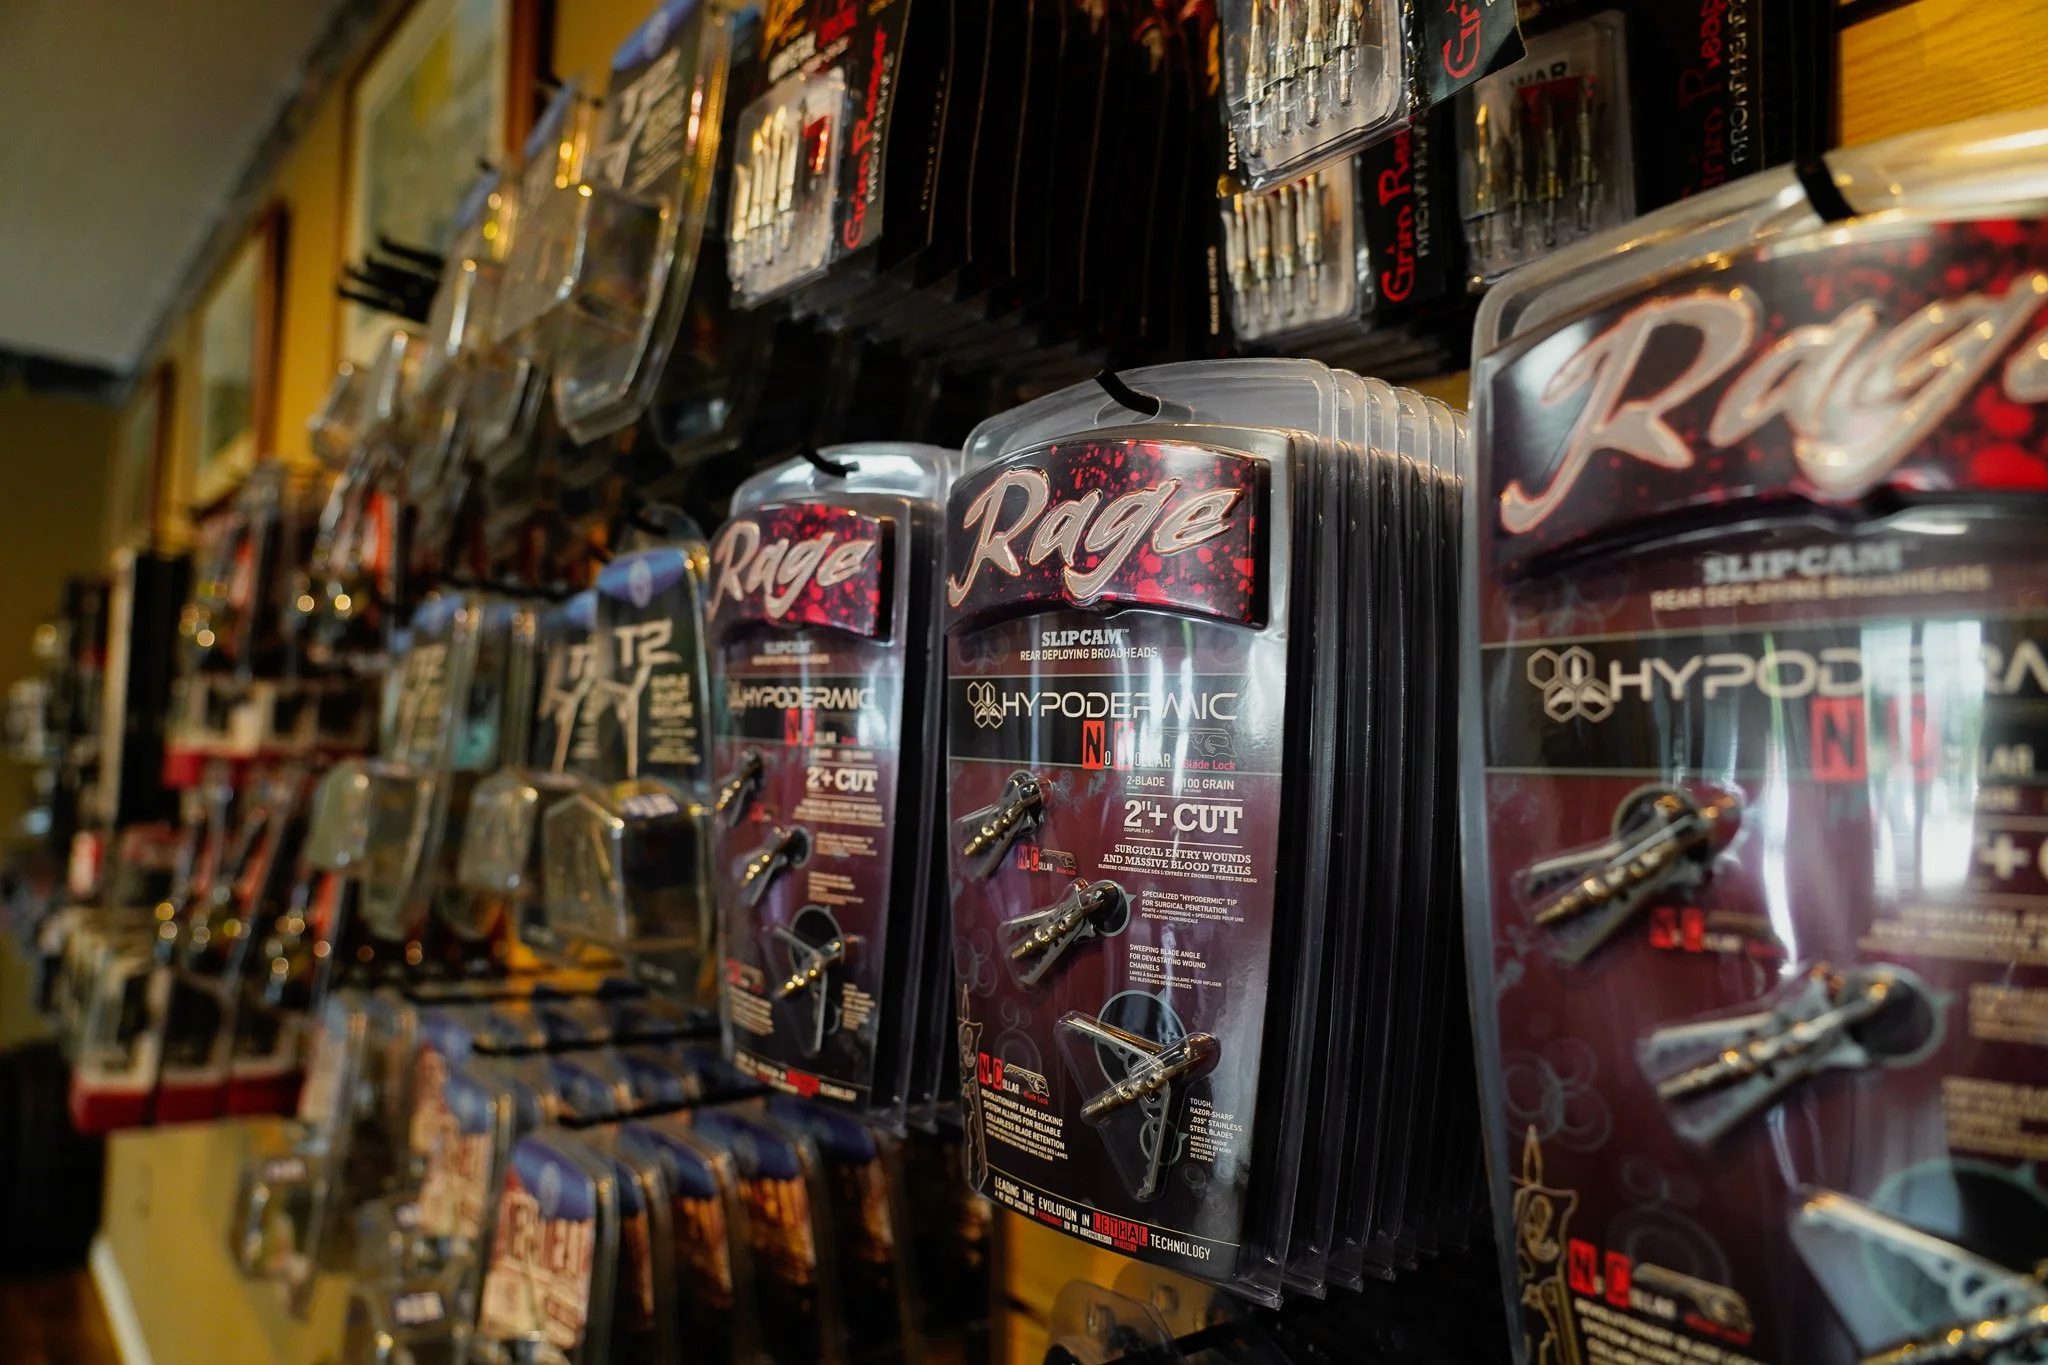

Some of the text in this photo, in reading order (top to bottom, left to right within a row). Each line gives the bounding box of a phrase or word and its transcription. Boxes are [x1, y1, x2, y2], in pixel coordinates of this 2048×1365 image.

[1442, 0, 1481, 78] Gr
[1382, 204, 1414, 302] Grim
[948, 466, 1242, 607] Rage
[708, 519, 876, 622] Rage
[1020, 647, 1158, 662] REAR DEPLOYING BROADHEADS
[1183, 759, 1236, 771] Blade Lock
[834, 768, 878, 792] CUT
[1126, 775, 1235, 791] 2-BLADE 100 GRAIN
[1173, 803, 1243, 834] CUT
[1115, 844, 1251, 864] SURGICAL ENTRY WOUNDS
[1103, 854, 1251, 876] AND MASSIVE BLOOD TRAILS
[1142, 890, 1179, 900] SPECIALIZED
[1227, 898, 1238, 906] TIP
[1142, 899, 1228, 914] FOR SURGICAL PENETRATION
[1129, 944, 1201, 959] SWEEPING BLADE ANGLE
[1129, 962, 1160, 971] CHANNELS
[1142, 954, 1181, 966] DEVASTATING
[1182, 960, 1206, 969] WOUND
[981, 1088, 1063, 1127] REVOLUTIONARY BLADE LOCKING
[1189, 1097, 1213, 1108] TOUGH,
[983, 1099, 1001, 1114] SYSTEM
[1001, 1107, 1022, 1122] ALLOWS
[1022, 1116, 1033, 1127] FOR
[1034, 1121, 1061, 1138] RELIABLE
[1189, 1106, 1234, 1120] RAZOR-SHARP
[985, 1111, 1014, 1131] COLLARLESS
[1014, 1124, 1032, 1138] BLADE
[1032, 1131, 1065, 1150] RETENTION
[1189, 1124, 1234, 1140] STEEL BLADES
[1208, 1120, 1243, 1132] STAINLESS
[995, 1175, 1019, 1199] LEADING
[1022, 1189, 1035, 1206] THE
[1093, 1212, 1148, 1246] LETHAL
[1150, 1233, 1211, 1260] TECHNOLOGY
